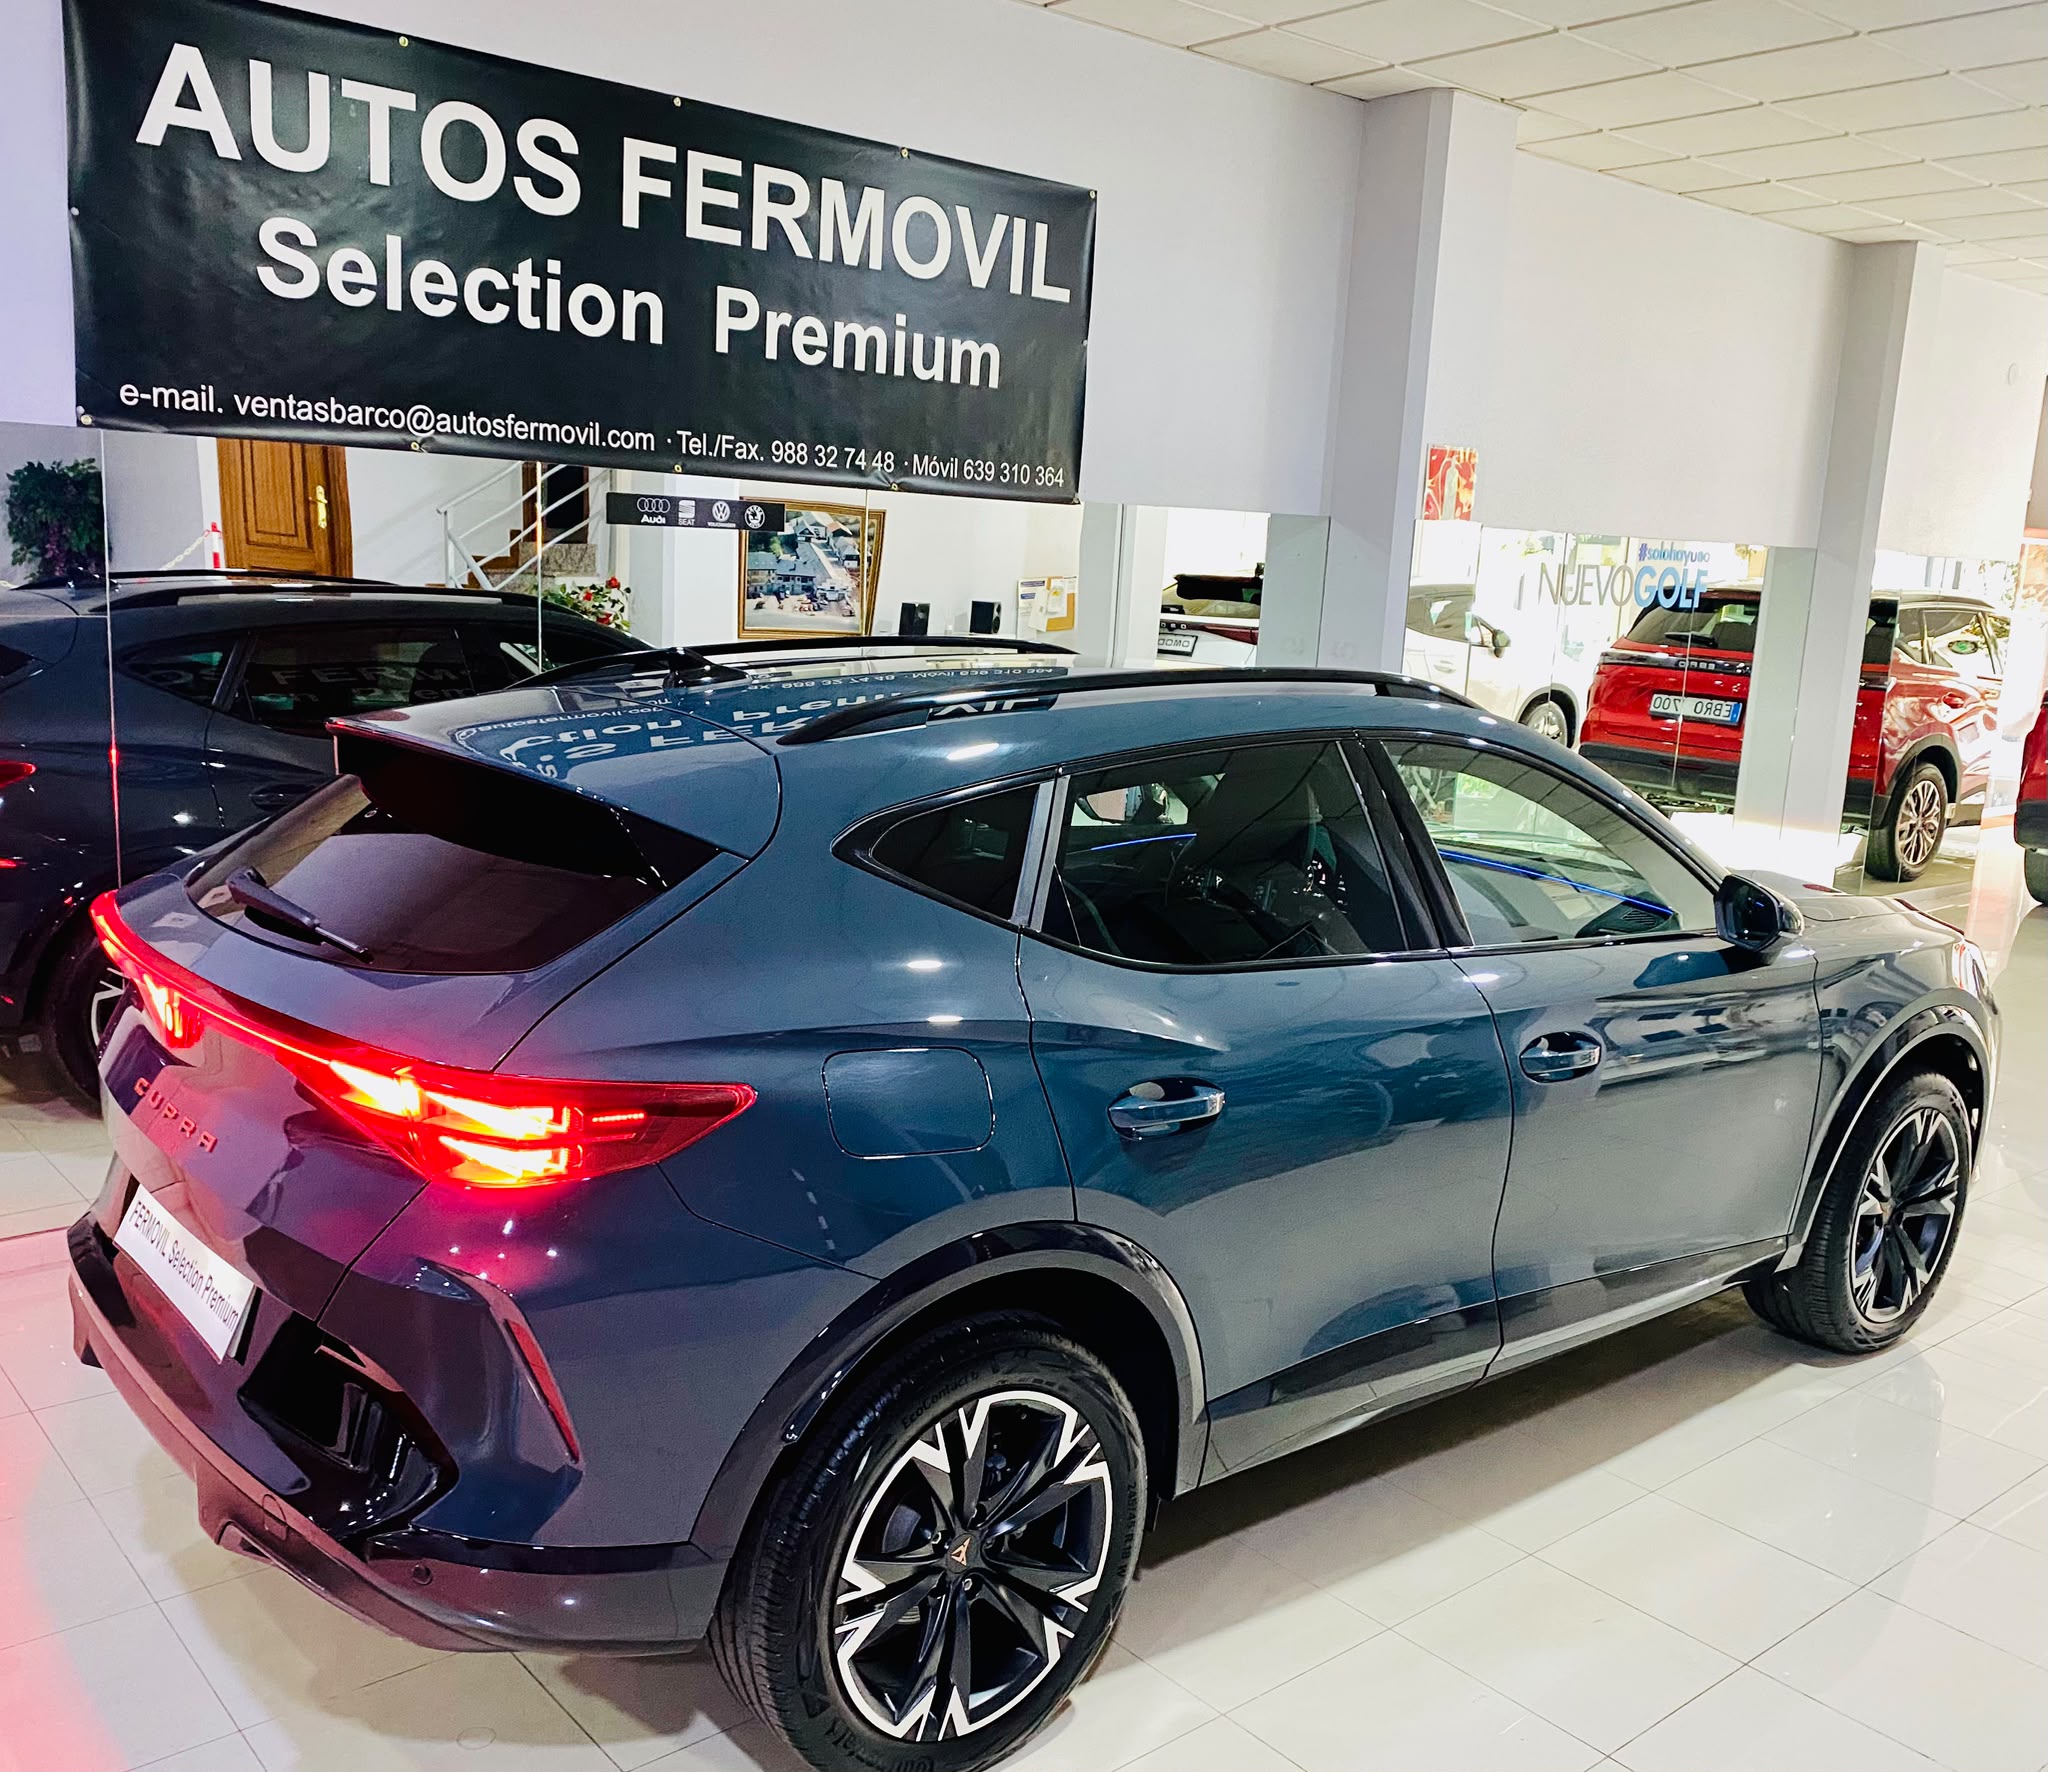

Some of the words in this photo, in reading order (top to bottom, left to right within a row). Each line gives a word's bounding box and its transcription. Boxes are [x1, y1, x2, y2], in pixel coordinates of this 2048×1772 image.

[136, 43, 580, 215] AUTOS
[622, 136, 1071, 303] FERMOVIL
[256, 216, 664, 345] Selection
[716, 285, 1000, 389] Premium
[119, 383, 223, 414] e-mail.
[234, 393, 655, 450] ventasbarco@autosfermovil.com
[676, 430, 765, 462] Tel./Fax.
[771, 440, 808, 465] 988
[815, 444, 838, 468] 32
[845, 447, 867, 471] 74
[871, 450, 895, 475] 48
[912, 453, 959, 479] Móvil
[963, 458, 995, 482] 639
[999, 462, 1031, 485] 310
[1034, 465, 1065, 488] 364
[641, 514, 666, 524] Audi
[678, 518, 695, 526] SEAT
[134, 1077, 218, 1153] CUPRA
[129, 1200, 169, 1258] FERMOVIL
[168, 1239, 204, 1297] Selection
[203, 1274, 239, 1332] Premium
